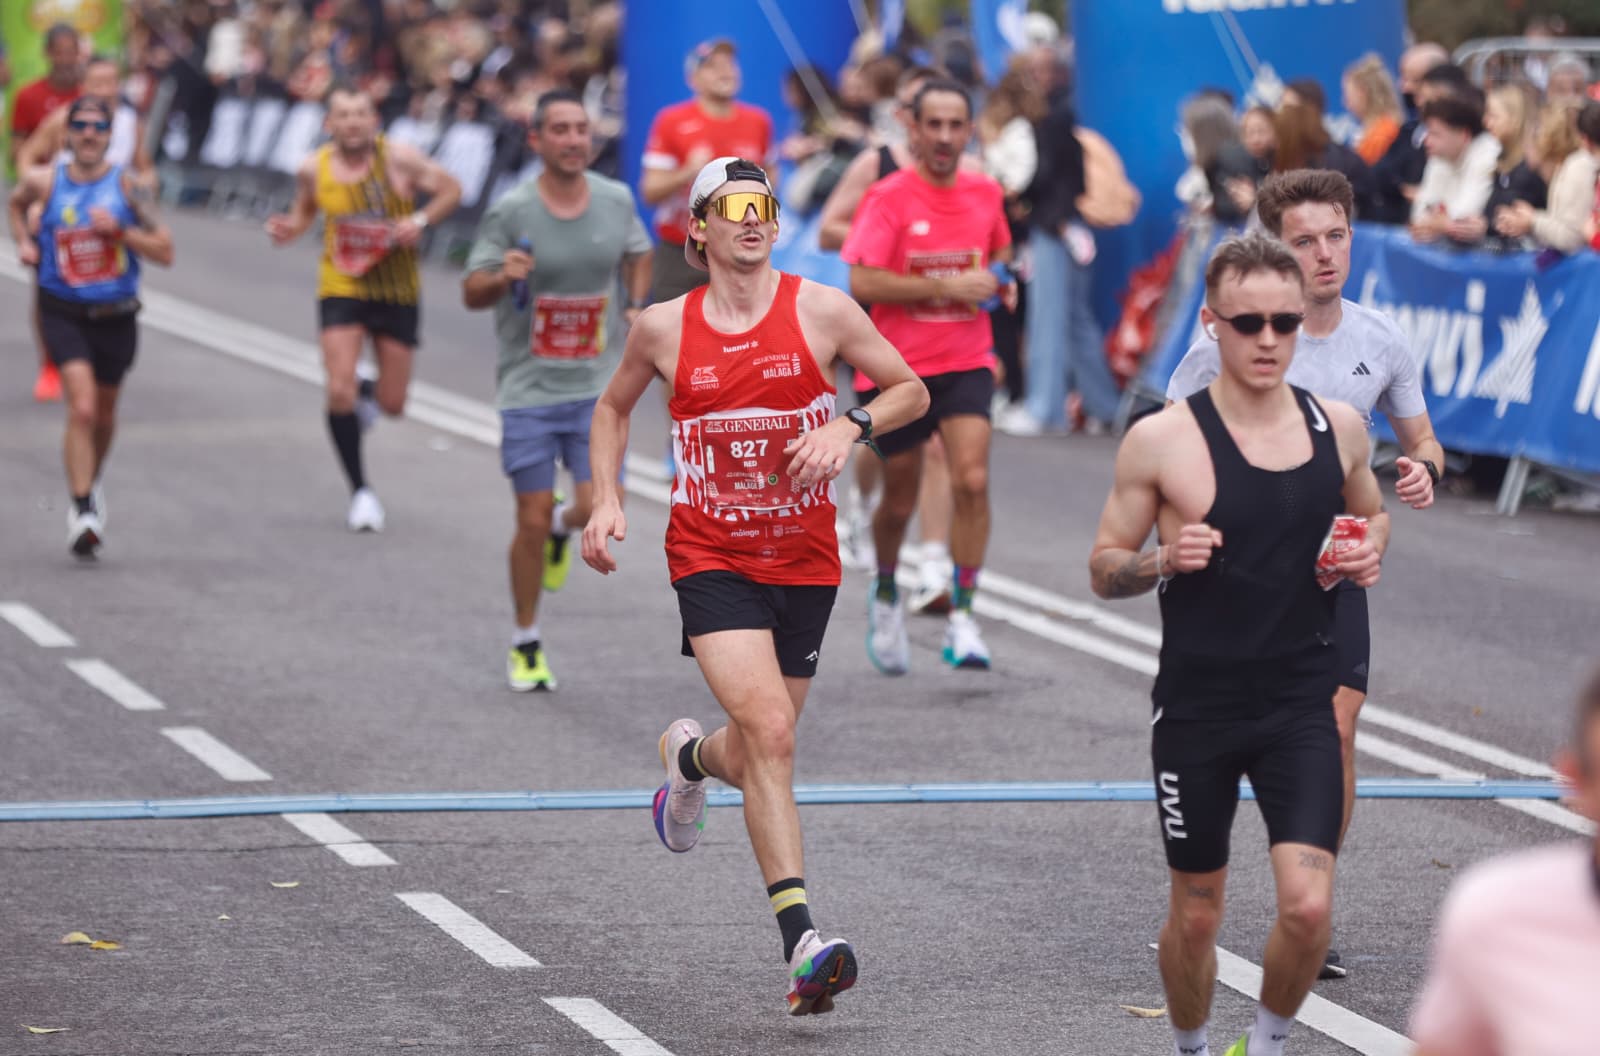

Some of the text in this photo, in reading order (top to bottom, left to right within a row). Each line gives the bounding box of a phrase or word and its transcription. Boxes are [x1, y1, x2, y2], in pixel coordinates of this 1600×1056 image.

[723, 342, 749, 353] luanvi
[724, 416, 790, 433] GENERALI
[730, 439, 769, 458] 827
[1159, 771, 1188, 839] UVU
